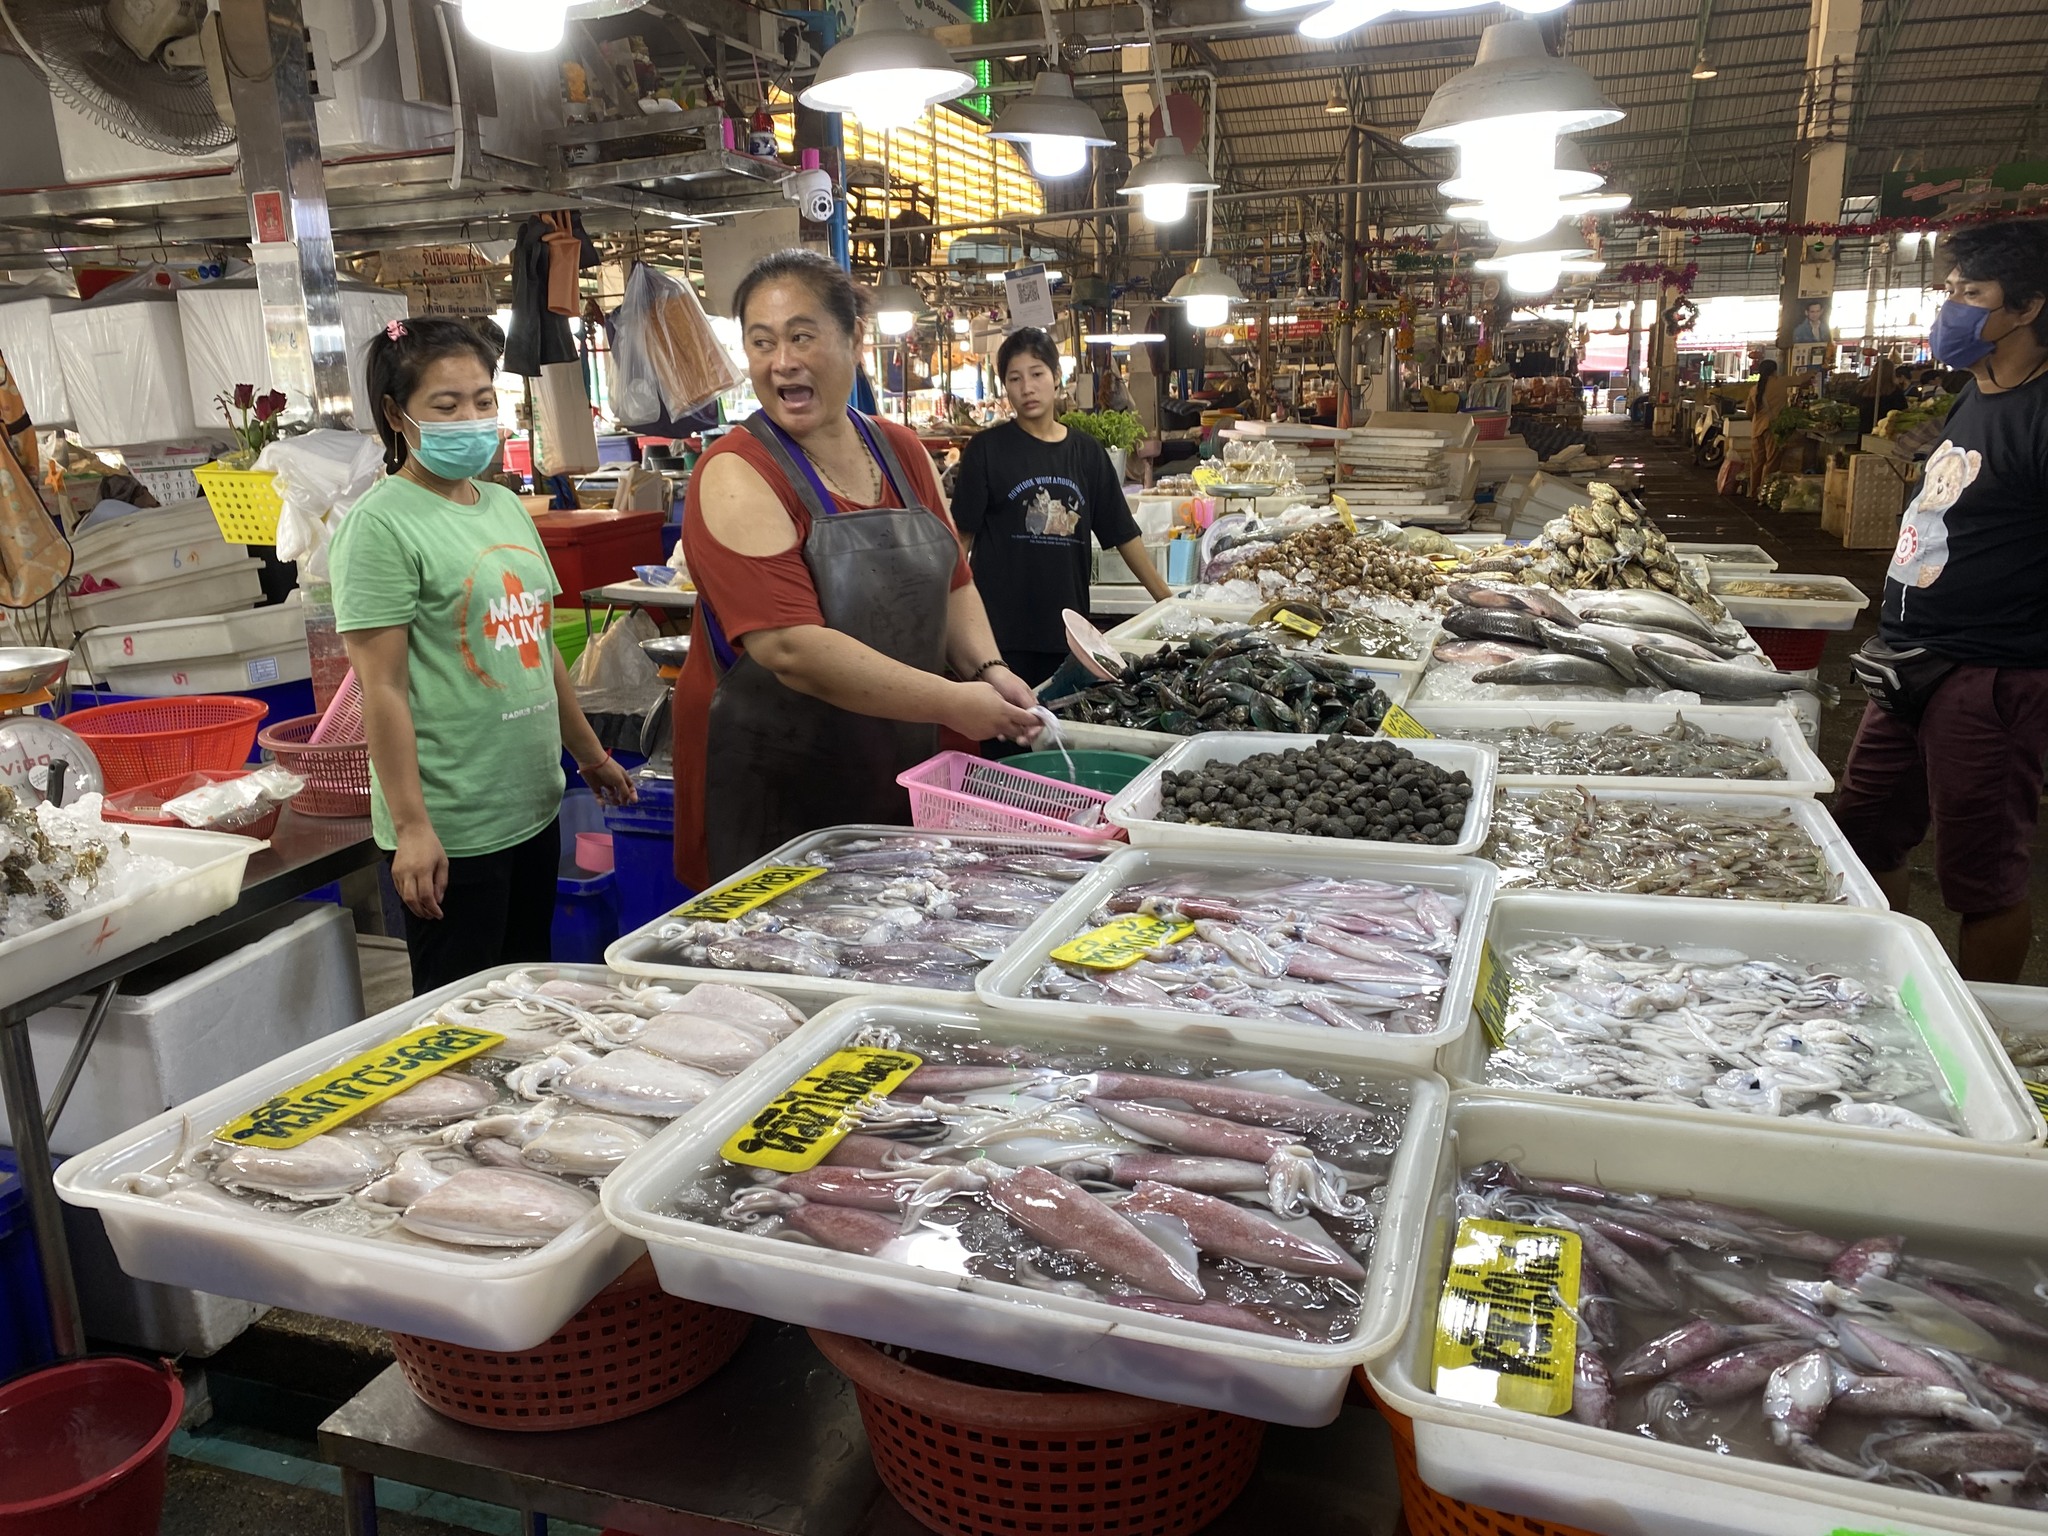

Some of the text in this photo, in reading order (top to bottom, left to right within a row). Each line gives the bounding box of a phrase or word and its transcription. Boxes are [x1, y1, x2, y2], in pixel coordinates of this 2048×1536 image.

[162, 482, 171, 490] 10
[489, 588, 546, 625] MADE
[494, 614, 546, 652] ALIVE
[501, 706, 531, 721] RADIUS
[233, 1028, 494, 1140] หมึกกระดอง
